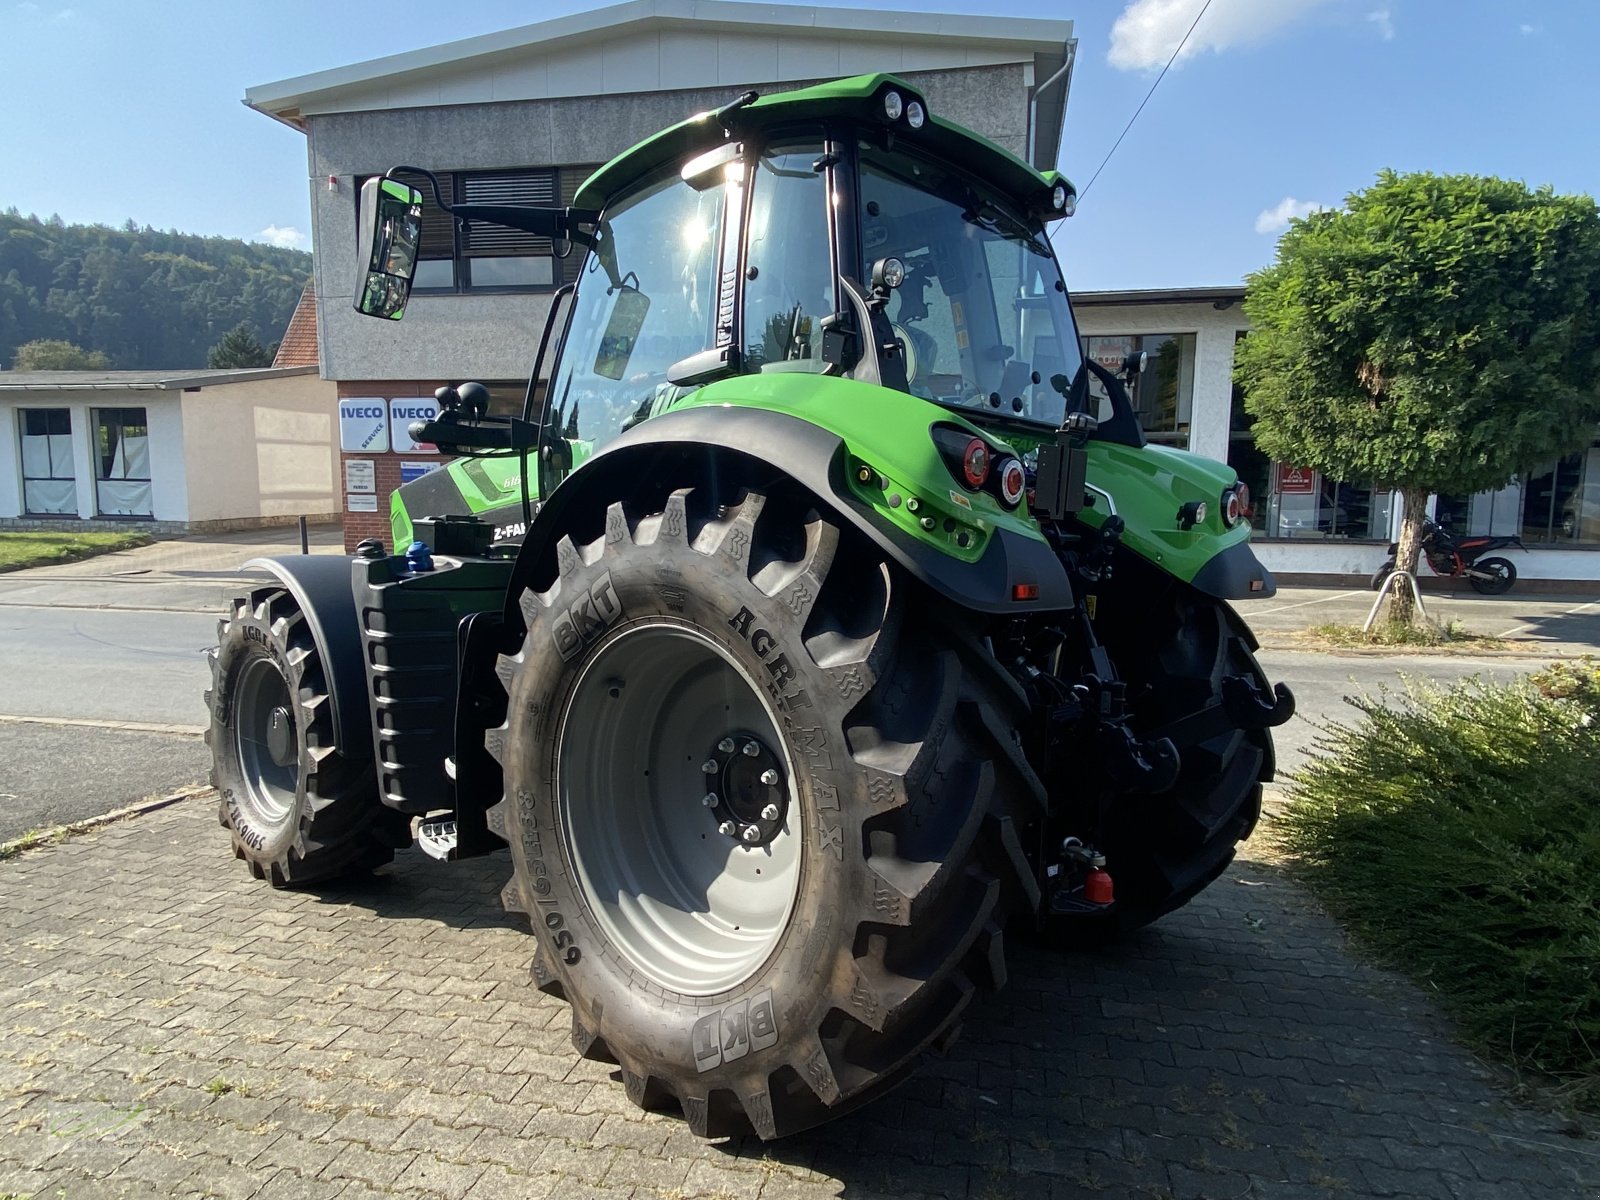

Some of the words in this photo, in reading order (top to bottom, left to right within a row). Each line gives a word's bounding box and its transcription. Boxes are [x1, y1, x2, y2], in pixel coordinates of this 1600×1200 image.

[341, 407, 383, 418] IVECO
[392, 407, 436, 419] IVECO
[361, 422, 385, 450] SERVICE
[553, 578, 617, 656] BKT
[695, 997, 777, 1064] BKT
